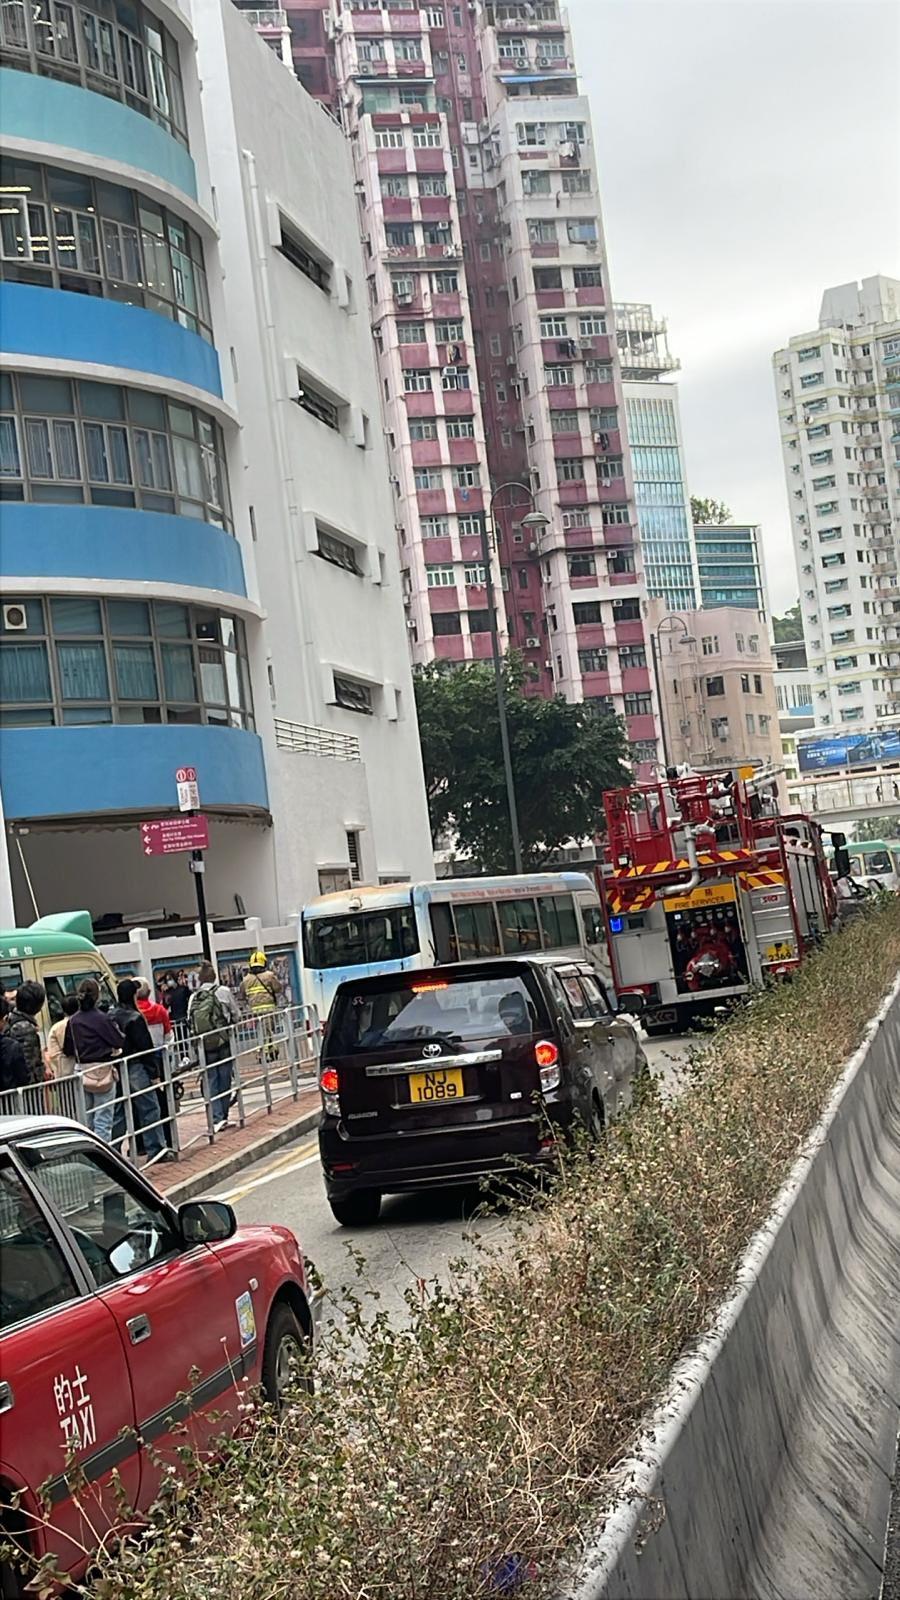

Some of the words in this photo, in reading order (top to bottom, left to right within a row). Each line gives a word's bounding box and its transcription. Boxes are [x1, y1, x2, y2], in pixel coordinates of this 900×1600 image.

[674, 901, 690, 909] FIRE
[691, 896, 725, 907] SERVICES
[425, 1071, 447, 1086] NJ
[417, 1083, 457, 1100] 1089
[53, 1365, 91, 1415] 的士
[59, 1403, 97, 1452] TAXI
